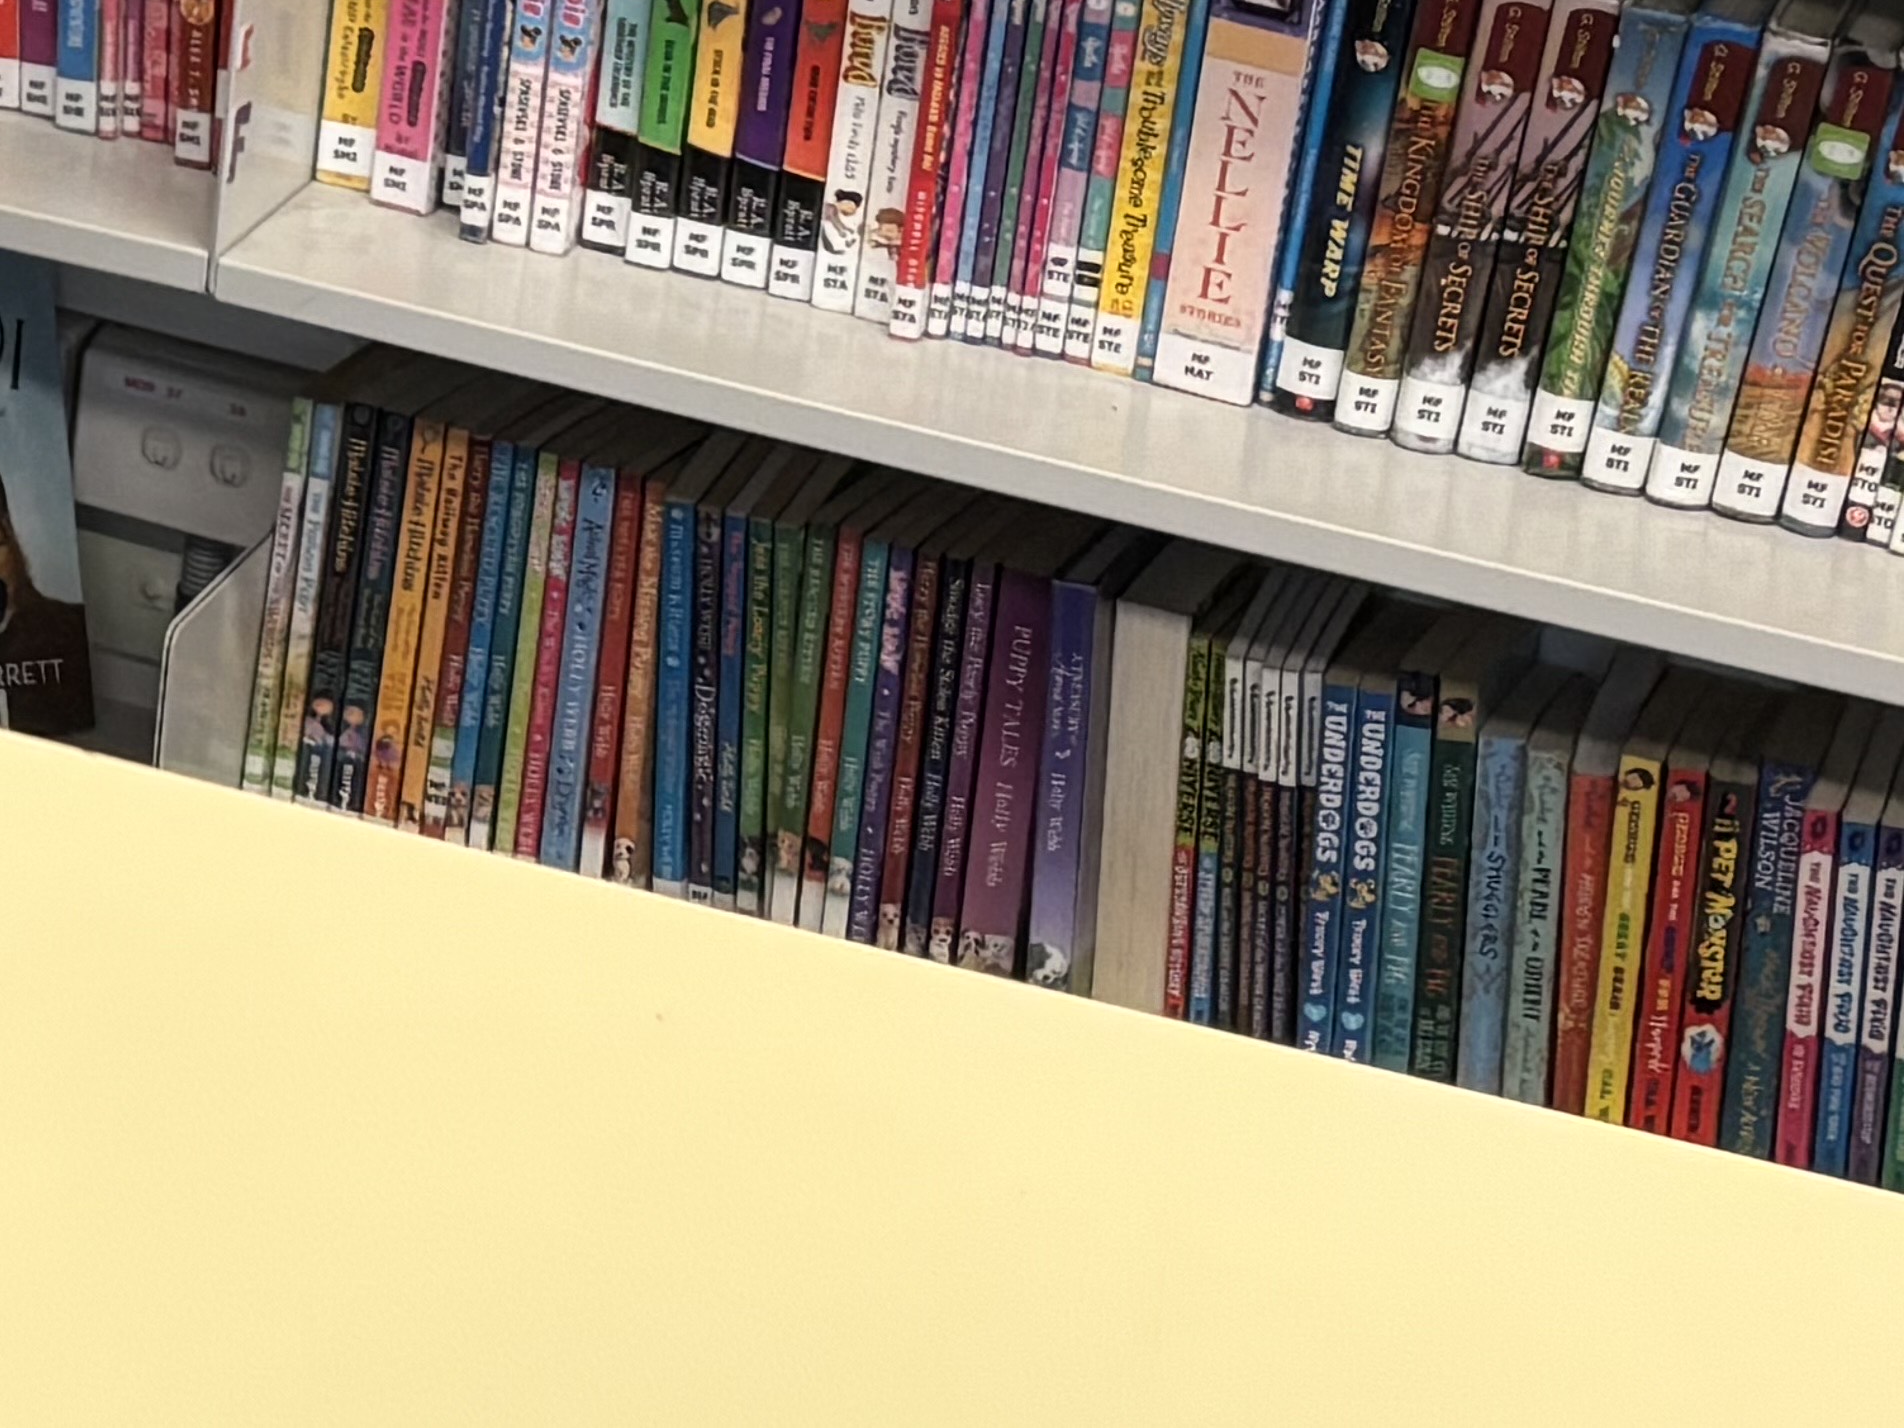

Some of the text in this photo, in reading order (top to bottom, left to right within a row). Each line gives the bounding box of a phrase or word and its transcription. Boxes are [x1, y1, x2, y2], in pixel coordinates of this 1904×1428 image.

[1196, 87, 1267, 307] NELLIE
[1322, 143, 1364, 301] TIME WARP
[1652, 181, 1698, 308] GUARDIAN
[1433, 261, 1473, 354] SECRETS
[1498, 265, 1541, 361] SECRETS
[1848, 244, 1899, 330] QUEST
[999, 623, 1034, 770] PUPPY TALES
[1711, 838, 1739, 890] PET
[1754, 811, 1782, 892] WILSON
[1772, 792, 1805, 917] JACQUELINE
